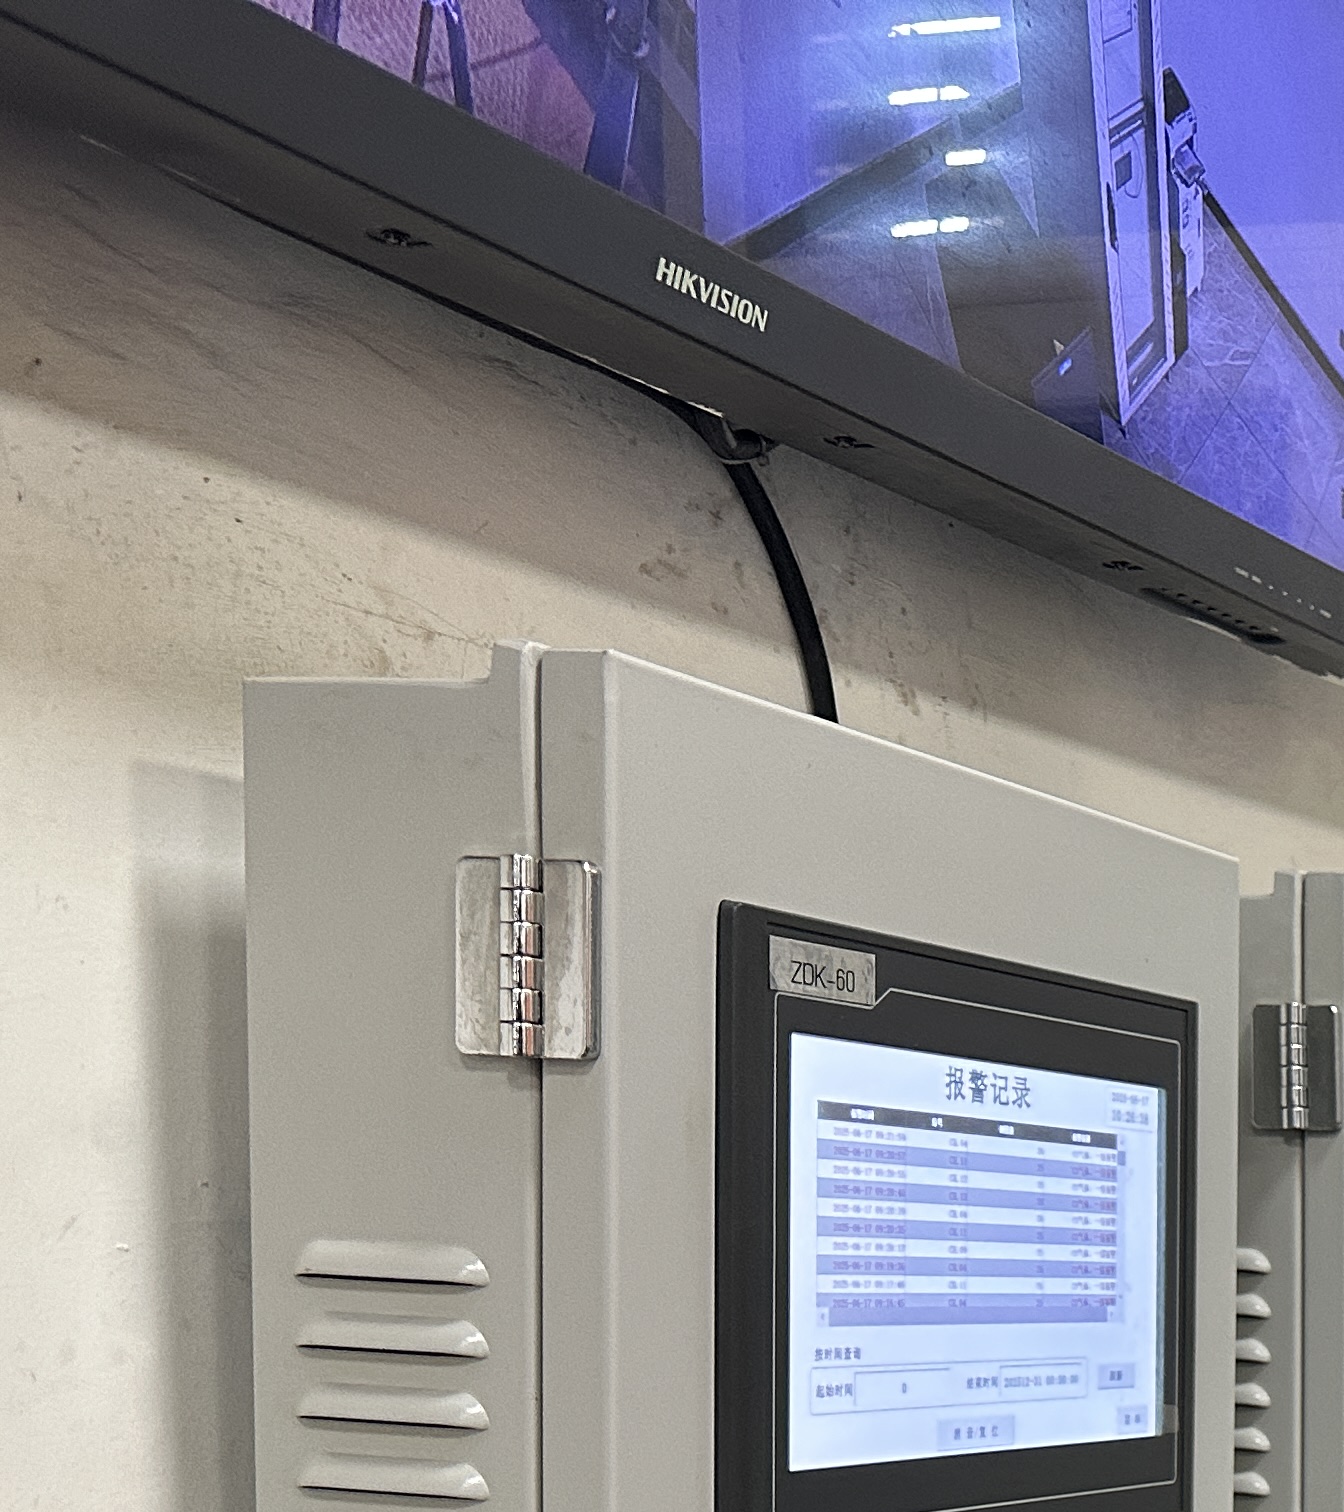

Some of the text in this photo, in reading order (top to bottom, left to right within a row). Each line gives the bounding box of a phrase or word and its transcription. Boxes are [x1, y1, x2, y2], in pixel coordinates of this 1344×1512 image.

[655, 257, 769, 333] HIKVISION
[791, 960, 855, 993] ZDK-60
[945, 1065, 1031, 1109] 报警记录
